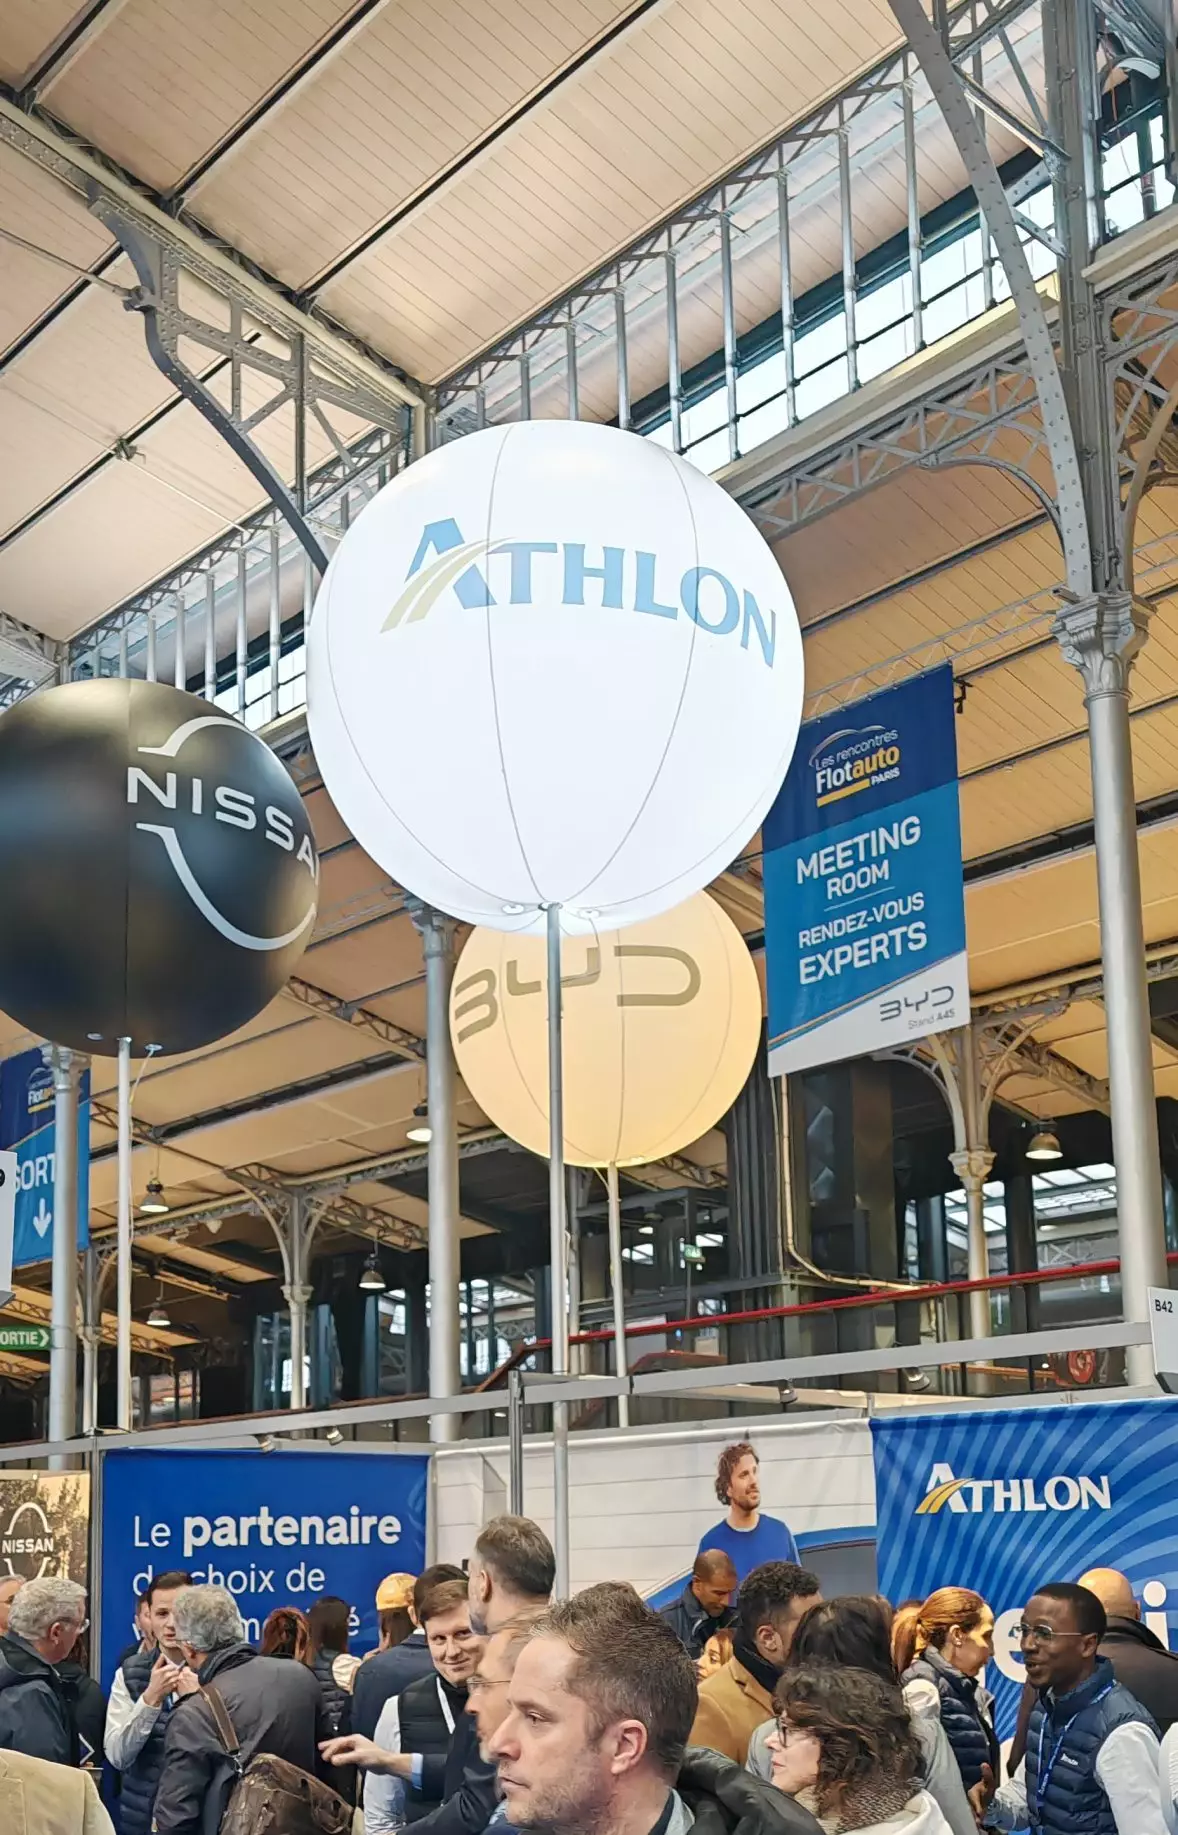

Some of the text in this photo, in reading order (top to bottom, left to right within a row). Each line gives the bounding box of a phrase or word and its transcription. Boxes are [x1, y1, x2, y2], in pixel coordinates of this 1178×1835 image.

[380, 517, 776, 669] ATHLON
[815, 729, 899, 771] Les rencontres
[815, 746, 900, 794] Flotauto
[870, 766, 900, 785] PARIS
[127, 767, 320, 886] NISSA
[797, 815, 921, 885] MEETING
[827, 859, 889, 900] ROOM
[798, 891, 925, 949] RENDEZ-VOUS
[799, 921, 928, 985] EXPERTS
[454, 944, 701, 1044] BYD
[880, 985, 955, 1022] BYD
[1154, 1299, 1173, 1313] B42
[0, 1330, 39, 1346] ORTIE
[915, 1462, 1112, 1515] ATHLON
[1, 1537, 54, 1554] NISSAN
[134, 1505, 402, 1557] Le partenaire
[286, 1561, 325, 1592] de
